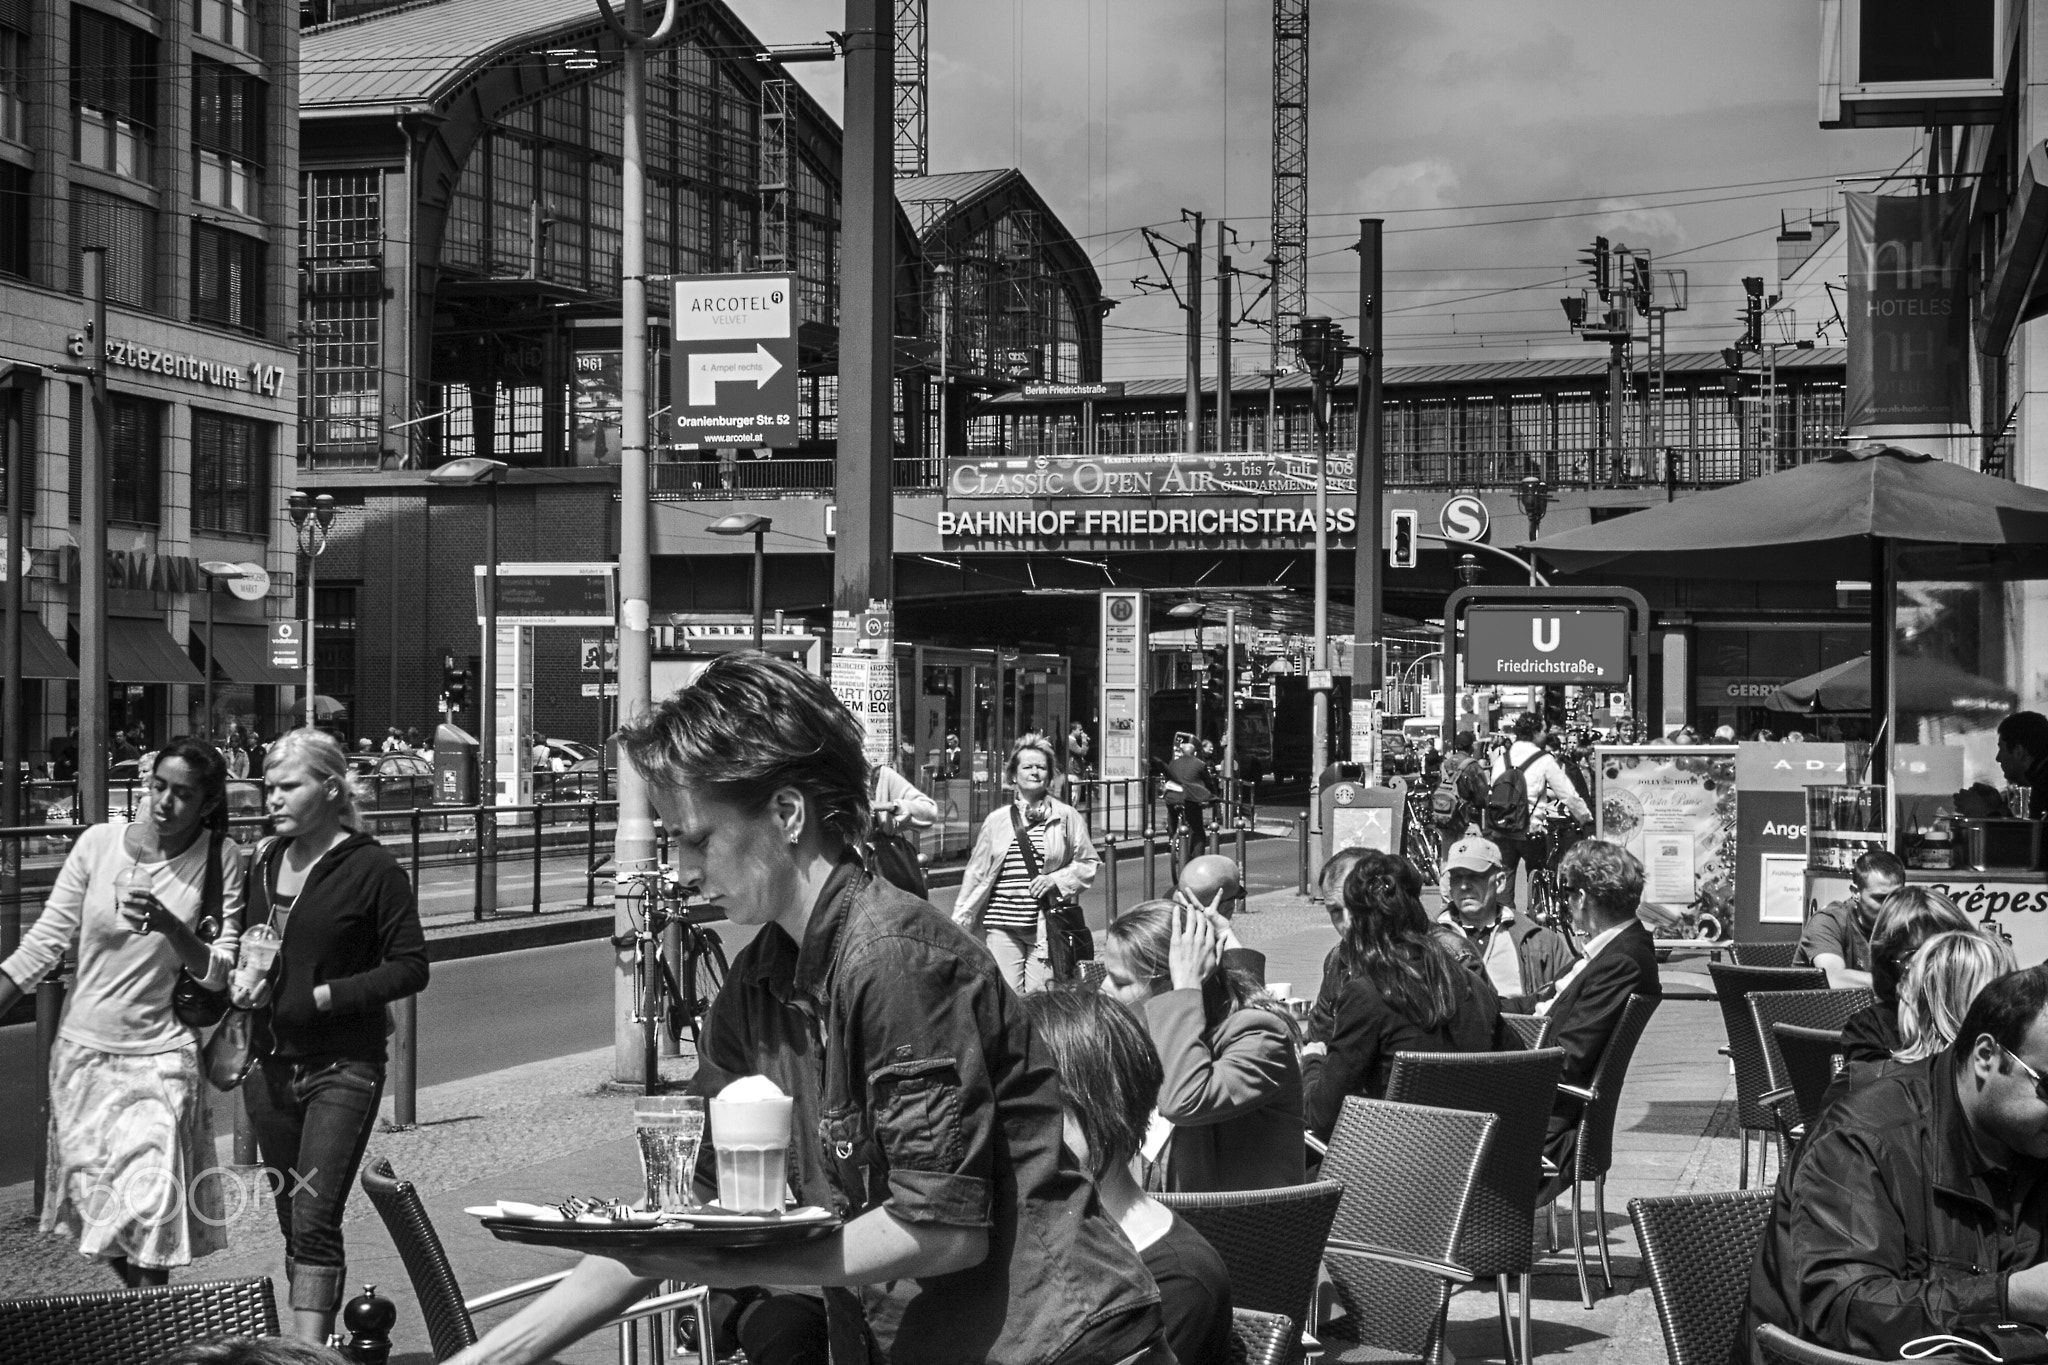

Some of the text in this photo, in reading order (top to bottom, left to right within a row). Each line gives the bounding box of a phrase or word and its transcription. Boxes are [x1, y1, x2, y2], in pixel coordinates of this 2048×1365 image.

[691, 296, 770, 312] ARCOTEL
[1867, 299, 1952, 317] HOTELES
[712, 314, 748, 325] VELVET
[69, 333, 285, 398] arztezentrum 147
[576, 357, 602, 371] 1961
[701, 363, 763, 374] 4. Ampel rechts
[1025, 384, 1107, 395] Berlin Friedrichstraße
[677, 414, 790, 429] Oranienburger Str. 52
[704, 433, 764, 443] www.arcotel.at
[1223, 462, 1237, 476] 3.
[1242, 461, 1262, 476] bis
[1285, 461, 1311, 476] Juli
[1325, 460, 1354, 477] 008
[1221, 478, 1356, 492] GENDARMENMRKT
[937, 510, 1076, 535] BAHNHOF
[1447, 499, 1481, 542] S
[1532, 617, 1560, 653] U
[1496, 659, 1595, 674] Friedrichstraße
